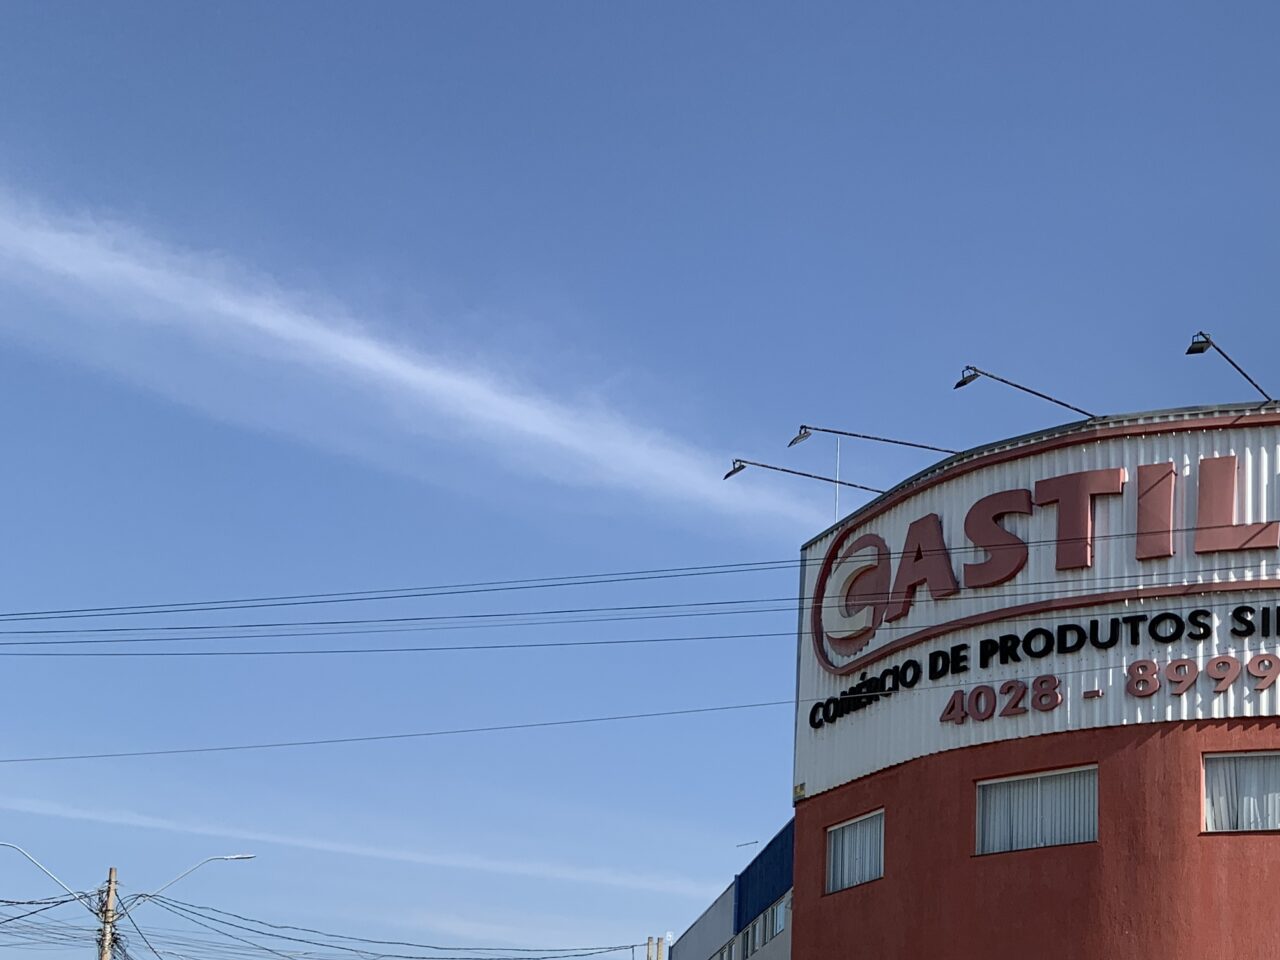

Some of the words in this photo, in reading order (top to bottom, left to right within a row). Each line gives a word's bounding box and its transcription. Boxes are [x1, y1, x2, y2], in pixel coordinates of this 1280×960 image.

[809, 659, 923, 729] COMÉRCIO
[929, 643, 972, 681] DE
[980, 609, 1213, 669] PRODUTOS
[940, 674, 1064, 726] 4028
